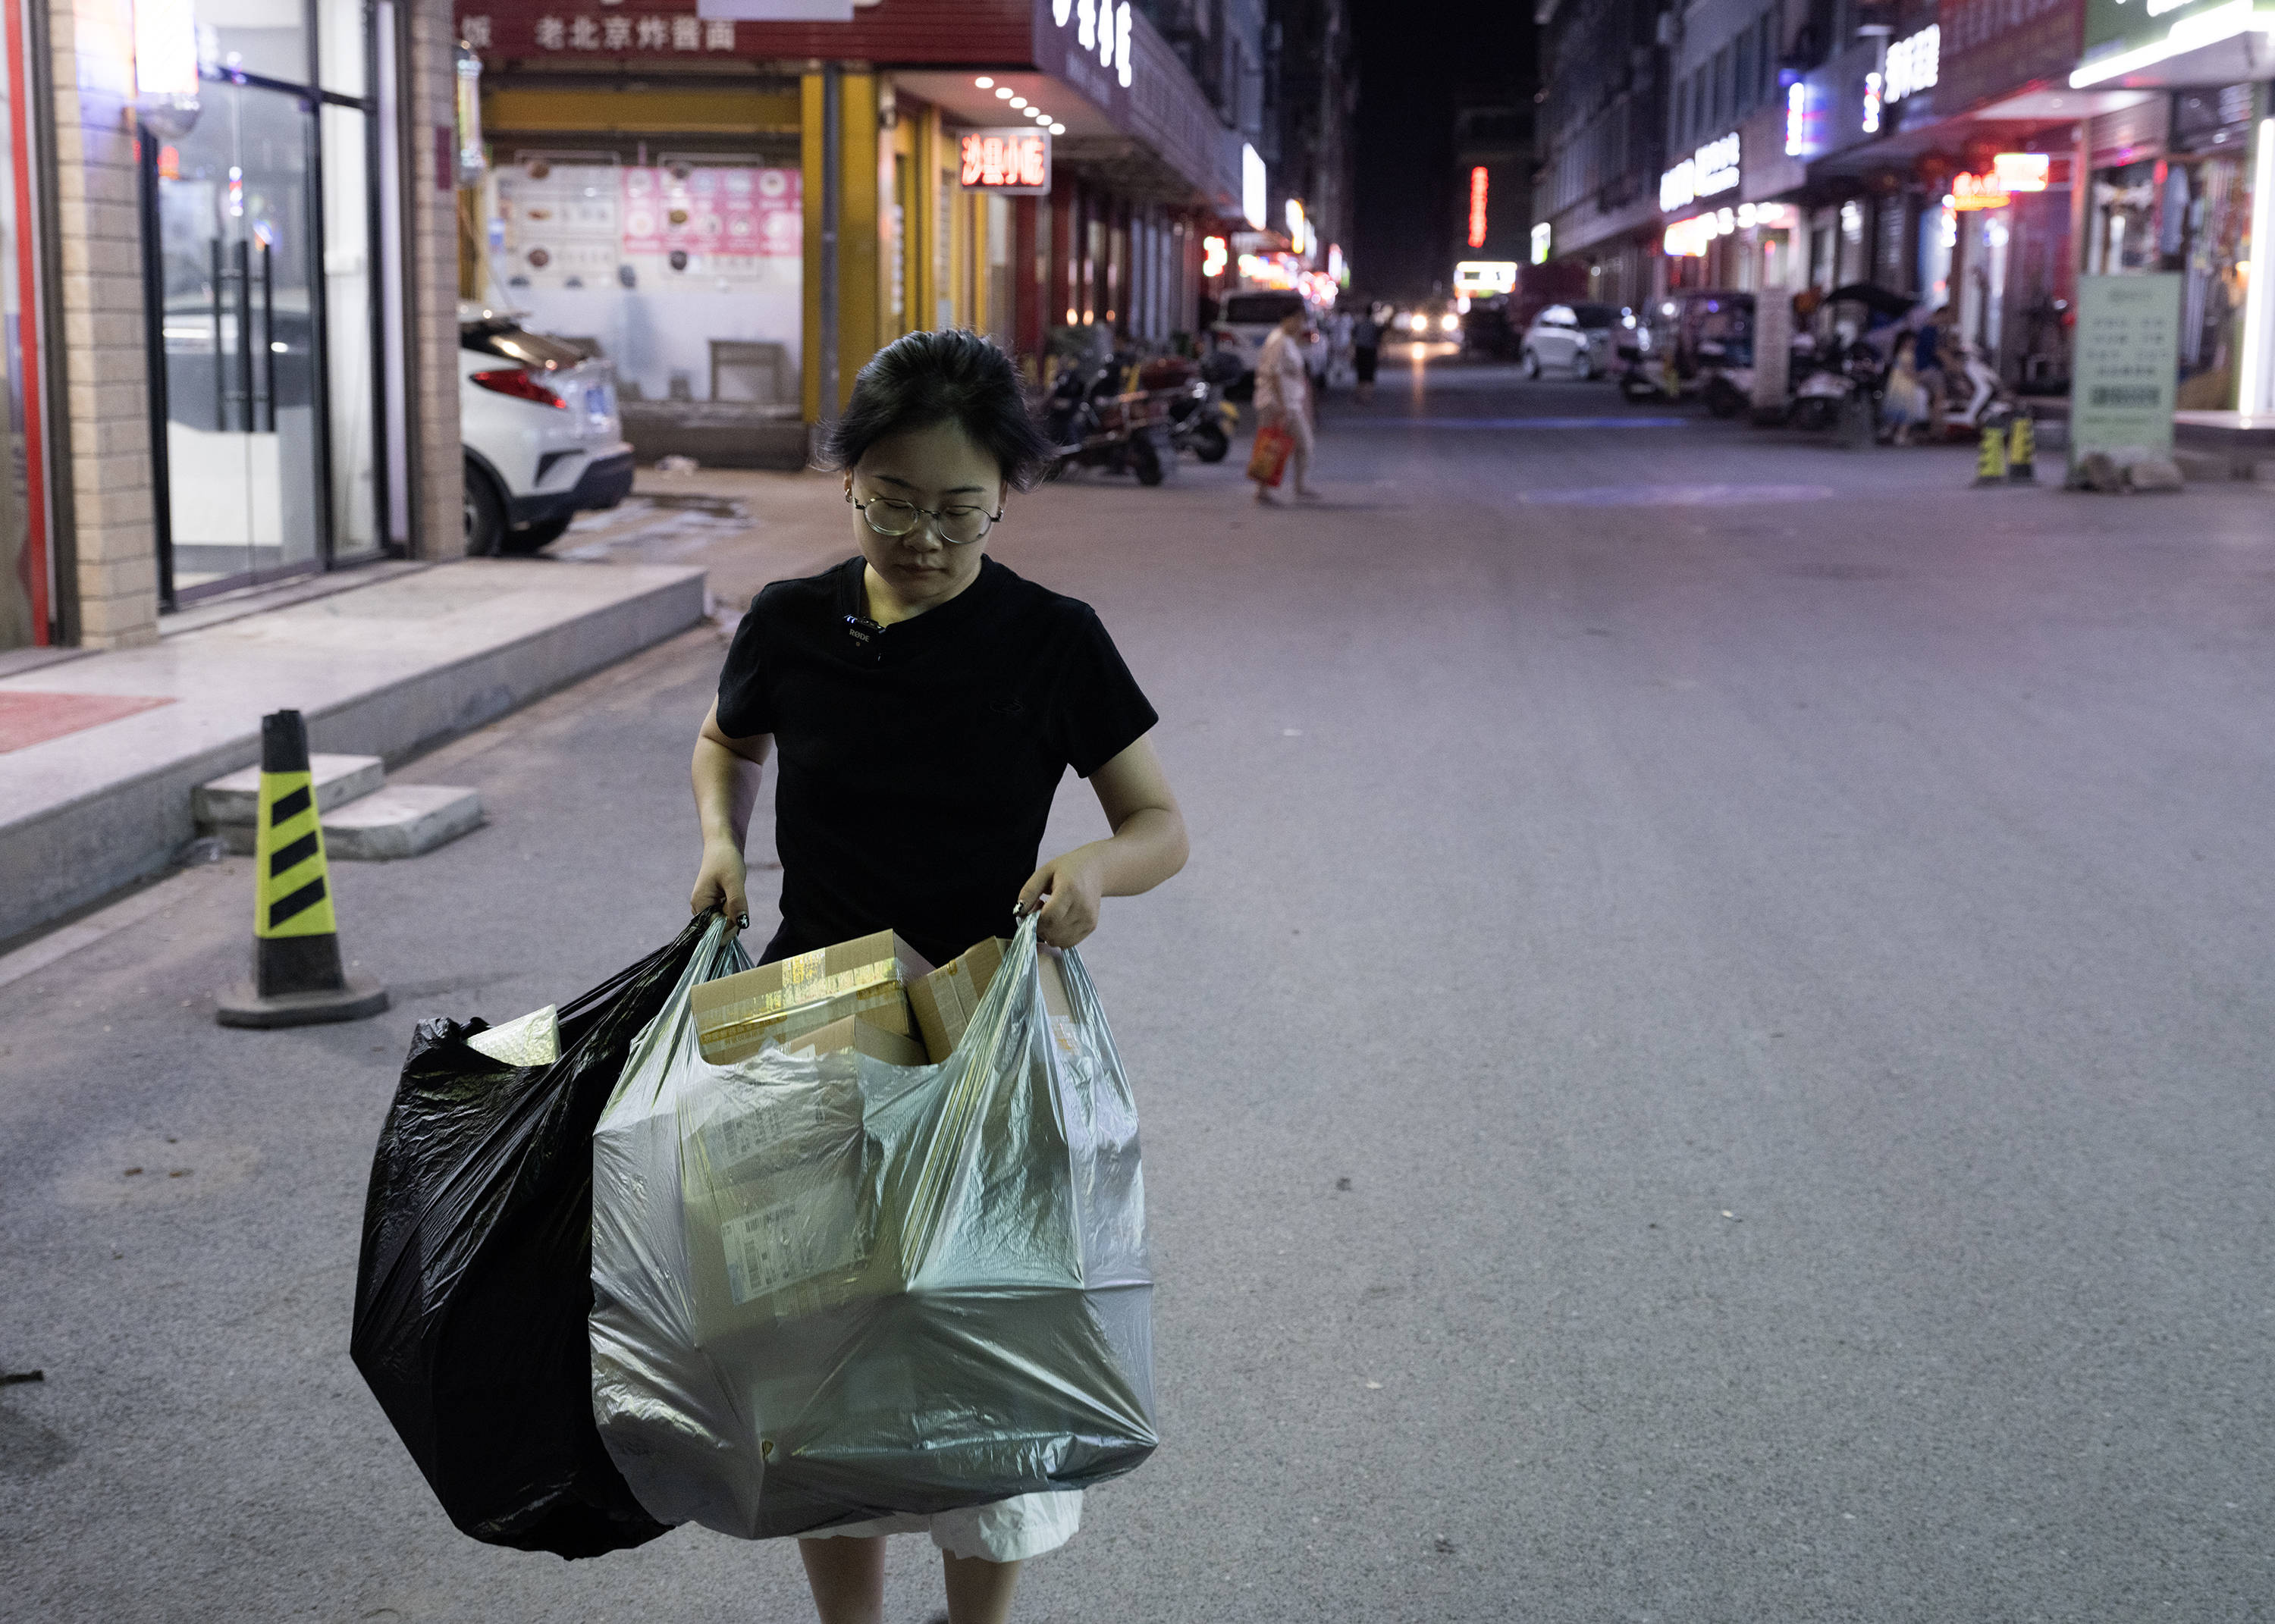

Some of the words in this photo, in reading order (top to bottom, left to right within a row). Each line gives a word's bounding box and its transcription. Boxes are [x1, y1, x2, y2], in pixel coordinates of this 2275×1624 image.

[535, 14, 736, 52] 老北京炸酱面
[962, 133, 1045, 185] 沙县小吃
[849, 629, 870, 642] RØDE
